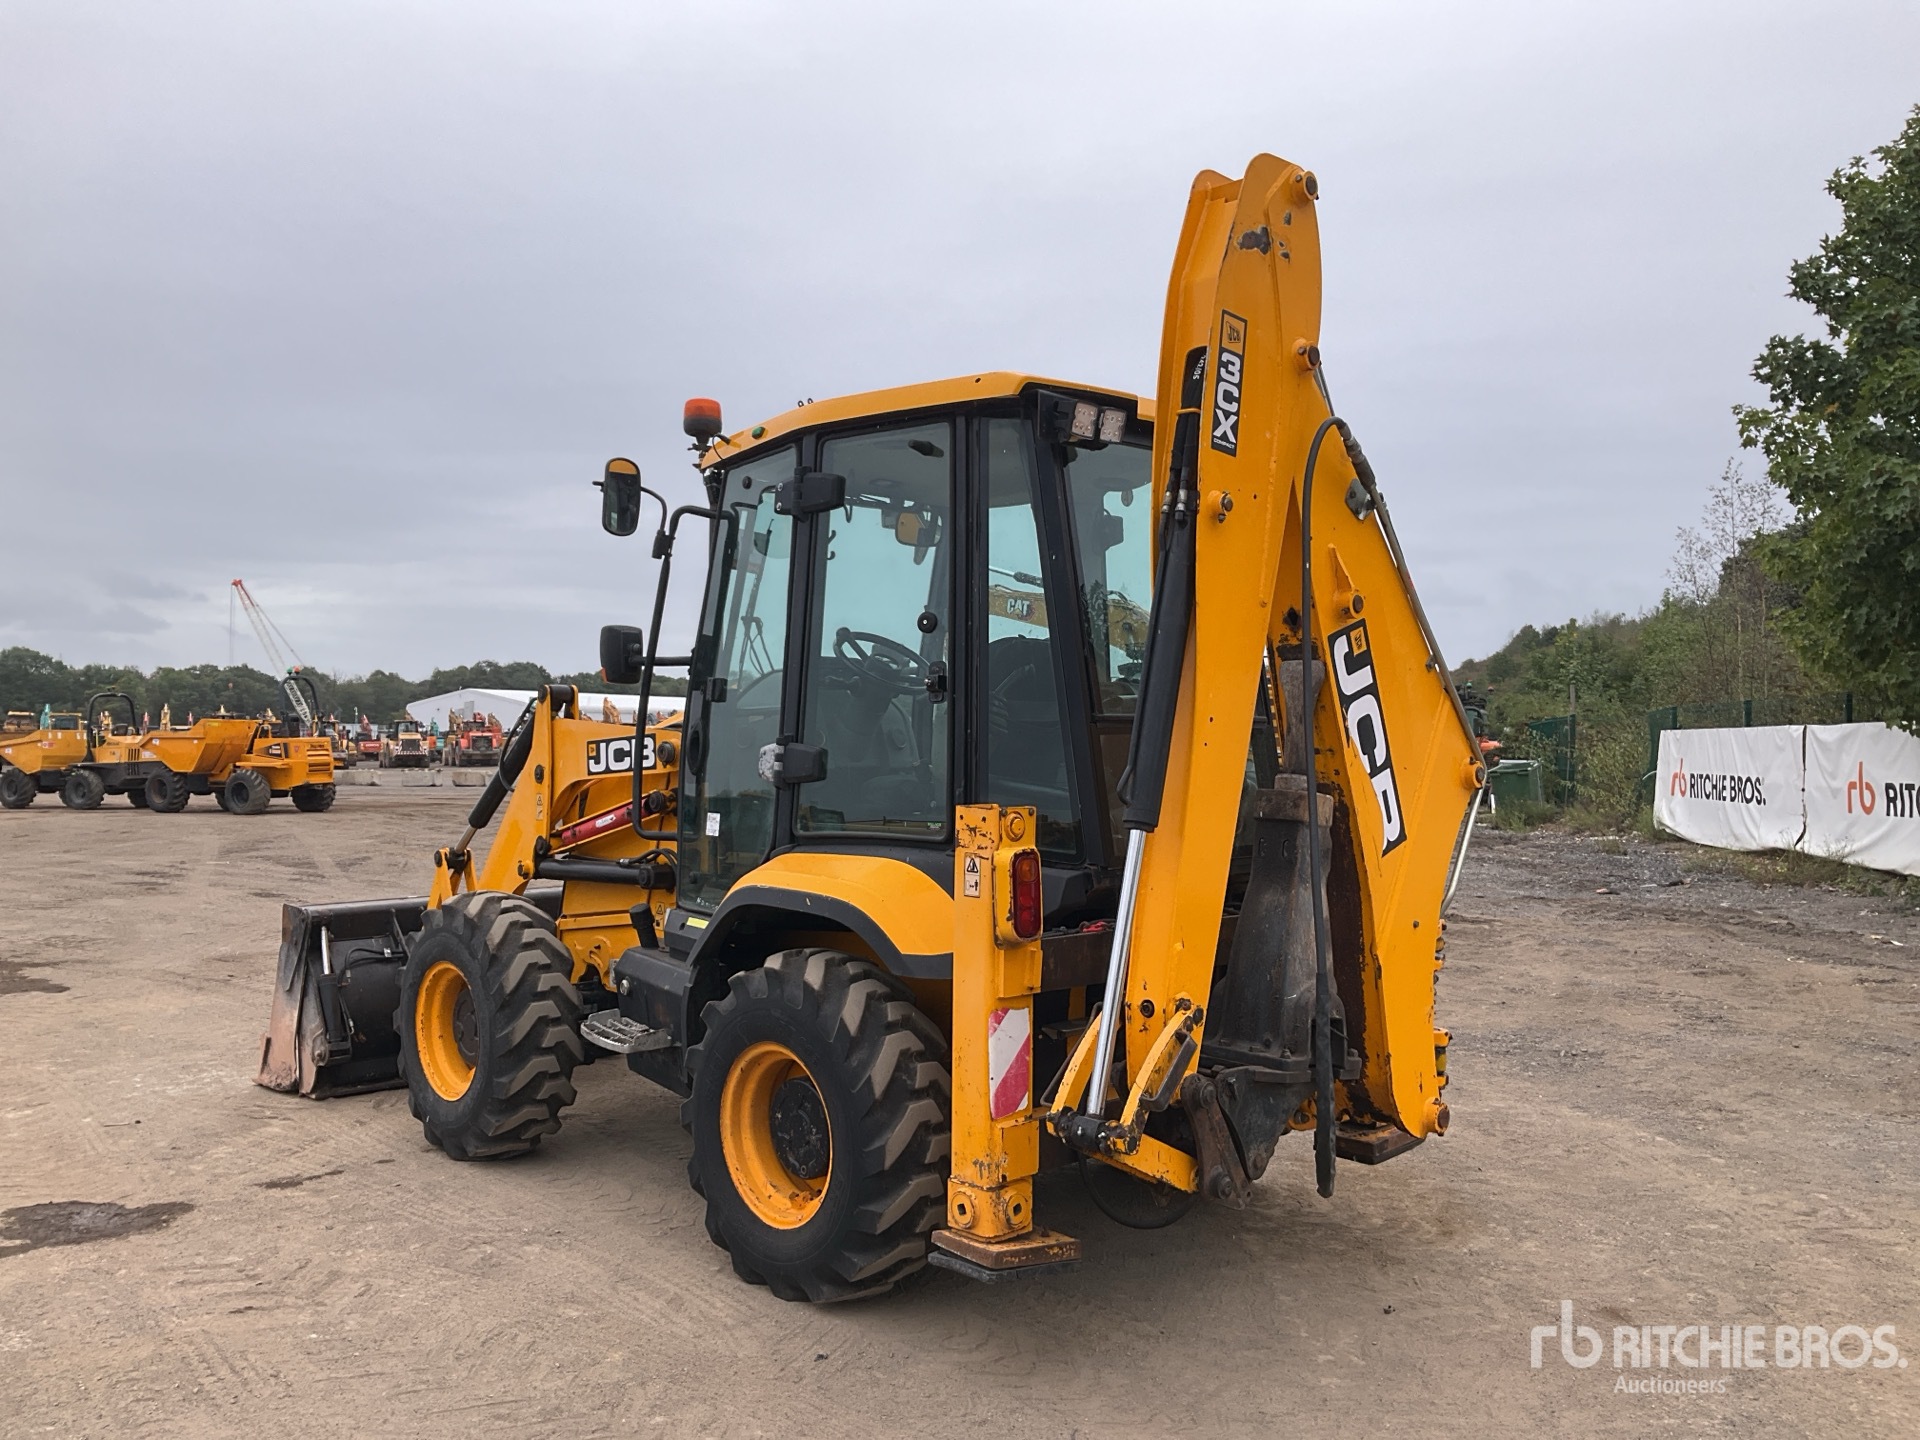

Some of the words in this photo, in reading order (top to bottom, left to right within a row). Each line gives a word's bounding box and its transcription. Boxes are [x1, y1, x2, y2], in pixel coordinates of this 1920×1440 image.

[1213, 352, 1241, 443] 3CX
[1007, 598, 1030, 616] CAT
[589, 737, 655, 773] JCB
[1689, 772, 1727, 801] RITCHIE
[1729, 775, 1767, 806] BROS.
